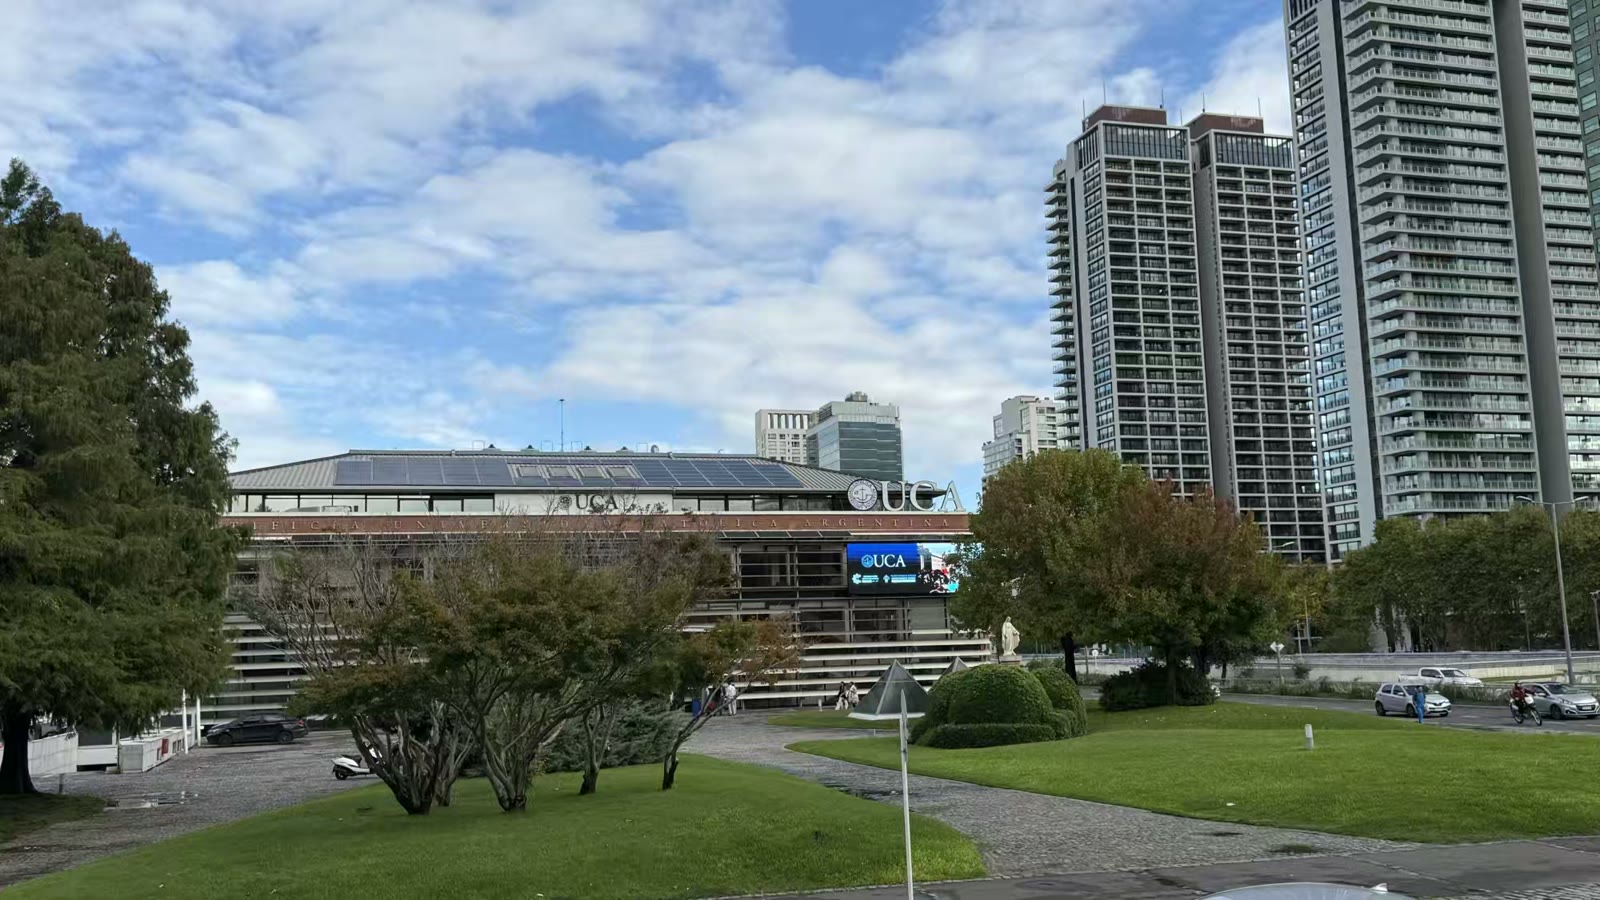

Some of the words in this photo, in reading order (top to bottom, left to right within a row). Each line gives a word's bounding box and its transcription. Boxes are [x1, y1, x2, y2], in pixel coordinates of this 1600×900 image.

[575, 494, 618, 510] UCA
[880, 479, 966, 512] UCA
[804, 519, 948, 528] ARGENTINA
[873, 554, 906, 567] UCA
